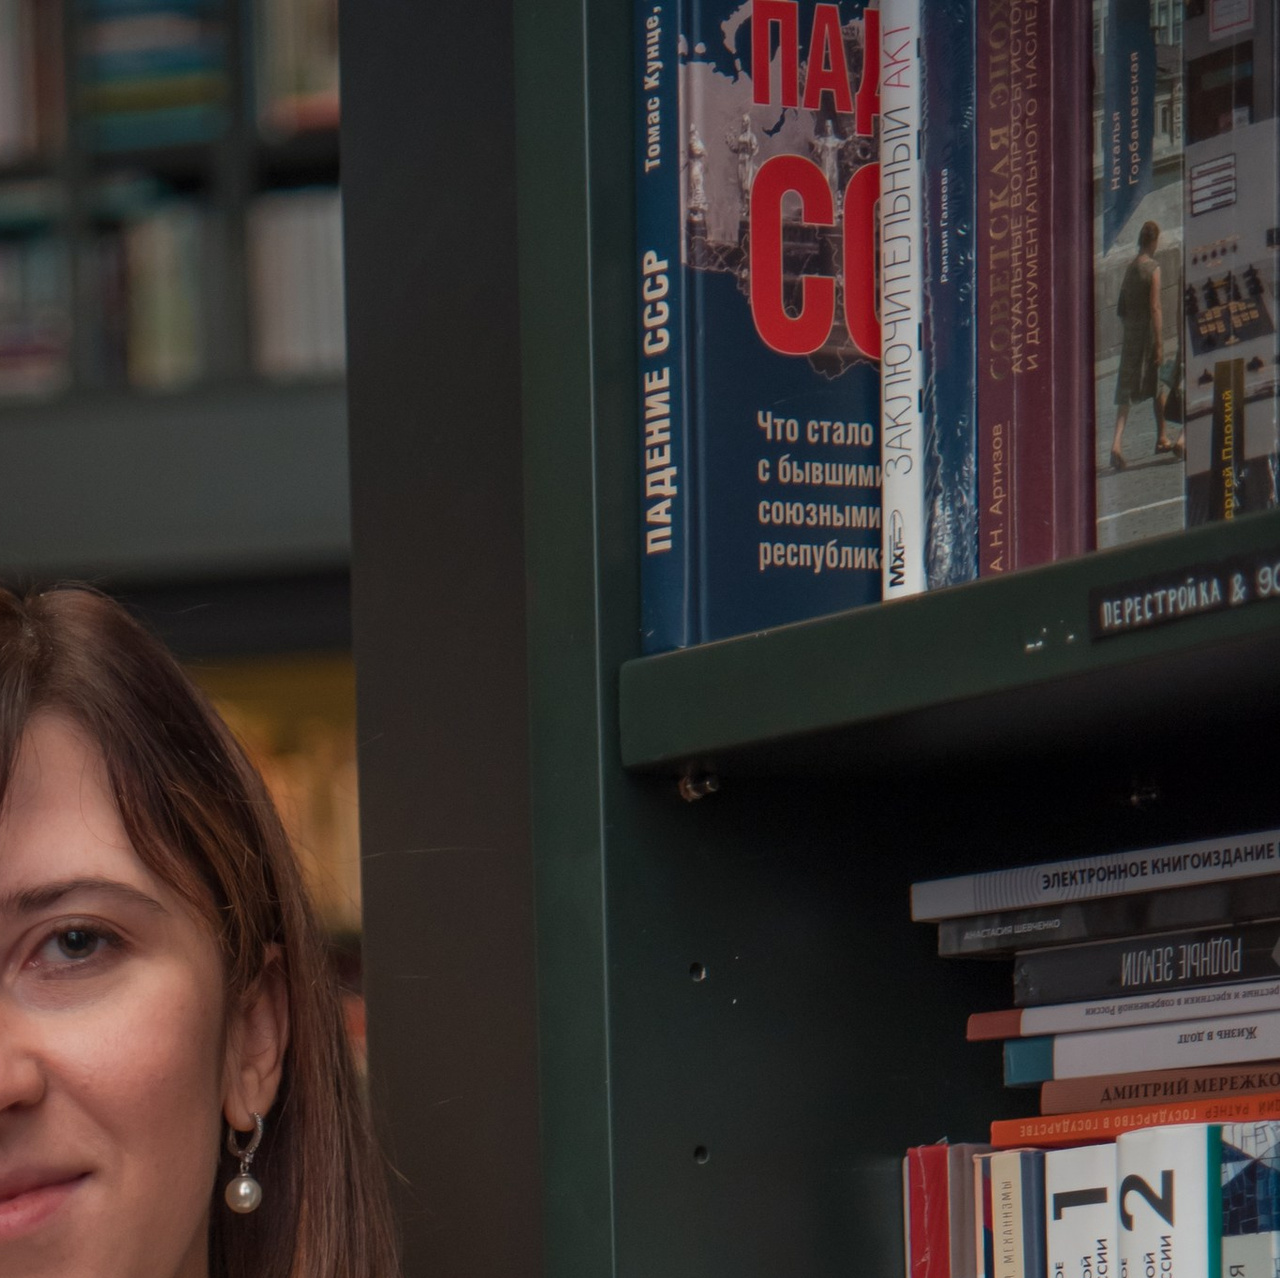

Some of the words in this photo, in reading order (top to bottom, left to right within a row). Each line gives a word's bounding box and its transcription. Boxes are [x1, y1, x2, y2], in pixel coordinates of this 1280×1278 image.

[643, 5, 663, 90] Кунце,
[882, 25, 912, 88] АКТ
[1008, 0, 1022, 78] ИСТО
[1024, 0, 1039, 89] НАСЛЕ
[644, 97, 662, 172] Томас
[1127, 51, 1142, 186] Горбаневская
[1009, 82, 1023, 208] ВОПРОСЫ
[1110, 111, 1122, 192] Наталья
[939, 167, 950, 224] Галеева
[1024, 98, 1041, 345] ДОКУМЕНТАЛЬНОГО
[940, 227, 950, 284] Рамзия
[988, 126, 1011, 381] СОВЕТСКАЯ
[642, 249, 669, 357] СССР
[882, 106, 913, 478] ЗАКЛЮЧИТЕЛЬНЫЙ
[1009, 214, 1024, 374] АКТУАЛЬНЫЕ
[1026, 353, 1039, 371] И
[757, 410, 800, 442] Что
[807, 419, 874, 448] стало
[1221, 389, 1235, 460] Плохий
[643, 366, 677, 555] ПАДЕНИЕ
[757, 457, 771, 483] с
[988, 423, 1008, 515] Артизов
[757, 501, 881, 529] союзными
[758, 539, 881, 574] республик
[1100, 576, 1222, 630] ПЕРЕСТРОЙКА
[1228, 571, 1247, 606] &
[1042, 860, 1149, 891] ЭЛЕКТРОННОЕ
[1151, 842, 1276, 876] КНИГОИЗДАНИЕ
[963, 926, 1013, 941] АНАСТАСИЯ
[1014, 918, 1062, 935] ШЕВЧЕНКО
[1121, 946, 1174, 987] ЗЕМЛИ
[1178, 936, 1243, 980] РОДНЫЕ
[1084, 1006, 1116, 1016] России
[1117, 999, 1176, 1014] современной
[1183, 991, 1233, 1005] крестники
[1176, 1033, 1206, 1044] долг
[1206, 1030, 1214, 1041] в
[1216, 1026, 1259, 1040] Жизнь
[1099, 1077, 1190, 1104] ДМИТРИЙ
[1192, 1071, 1280, 1094] МЕРЕЖКО
[1204, 1102, 1251, 1119] РАТНЕР
[1019, 1117, 1099, 1137] ГОСУДАРСТВЕ
[1102, 1117, 1110, 1130] В
[1113, 1107, 1197, 1128] ГОСУДАРСТВО
[1053, 1186, 1108, 1221] 1
[1119, 1168, 1175, 1232] 2
